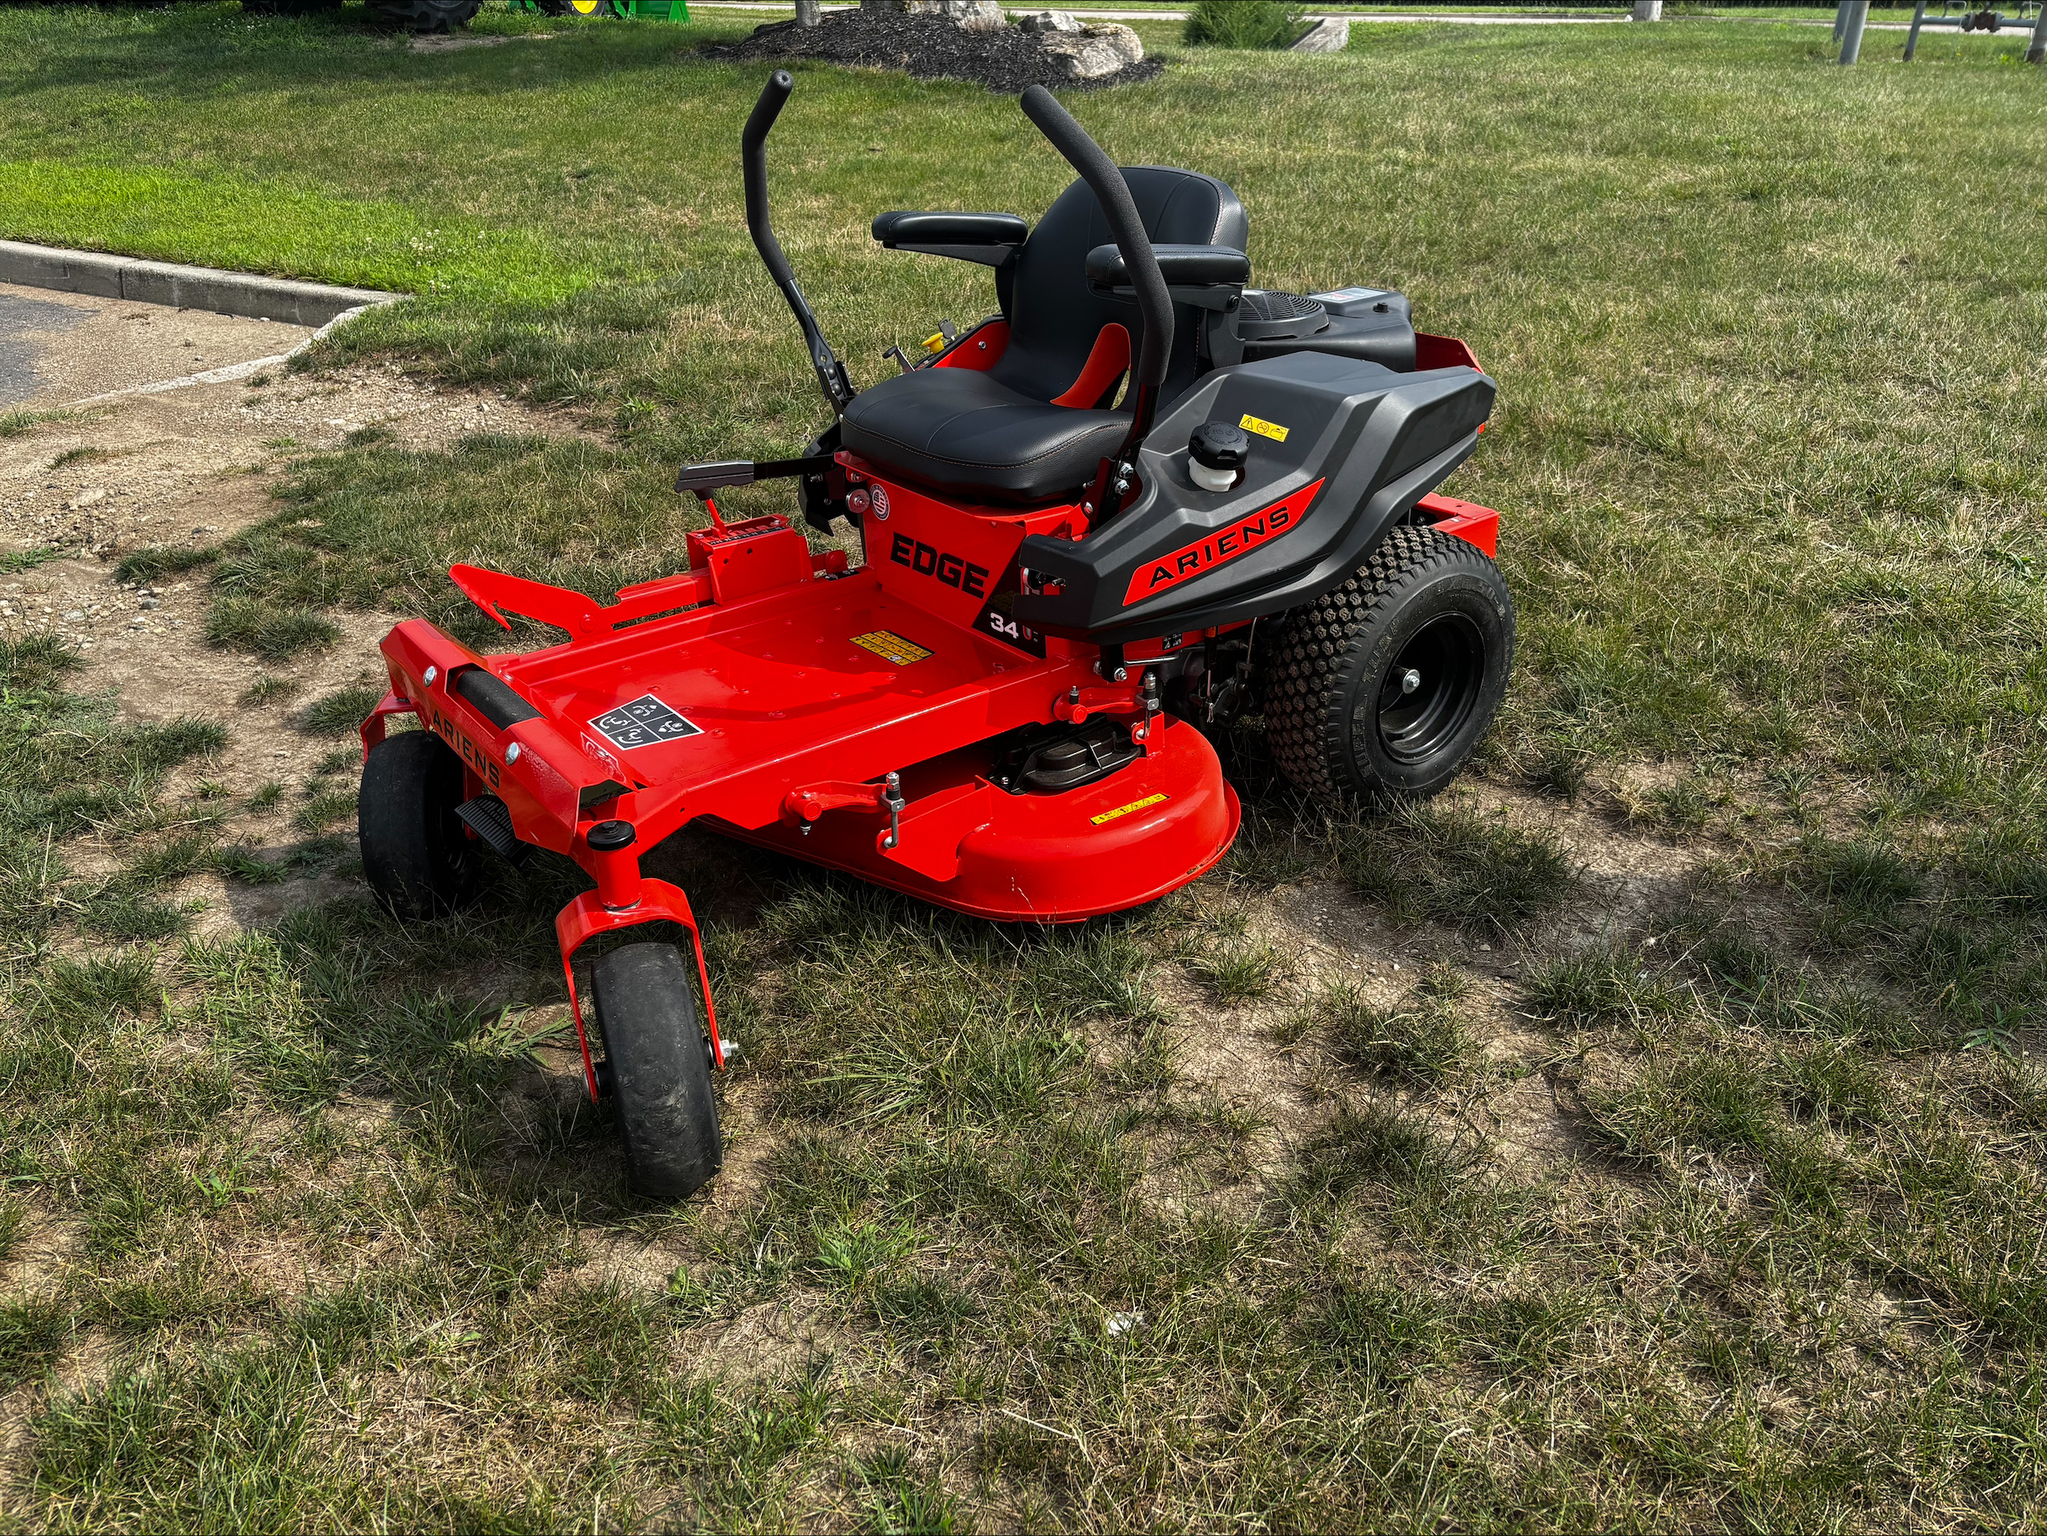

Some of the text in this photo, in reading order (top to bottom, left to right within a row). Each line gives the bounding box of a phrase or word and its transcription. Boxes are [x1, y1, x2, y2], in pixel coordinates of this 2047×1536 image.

[890, 532, 990, 600] EDGE
[1149, 506, 1290, 588] ARIENS
[990, 612, 1019, 639] 34
[433, 709, 500, 789] ARIENS
